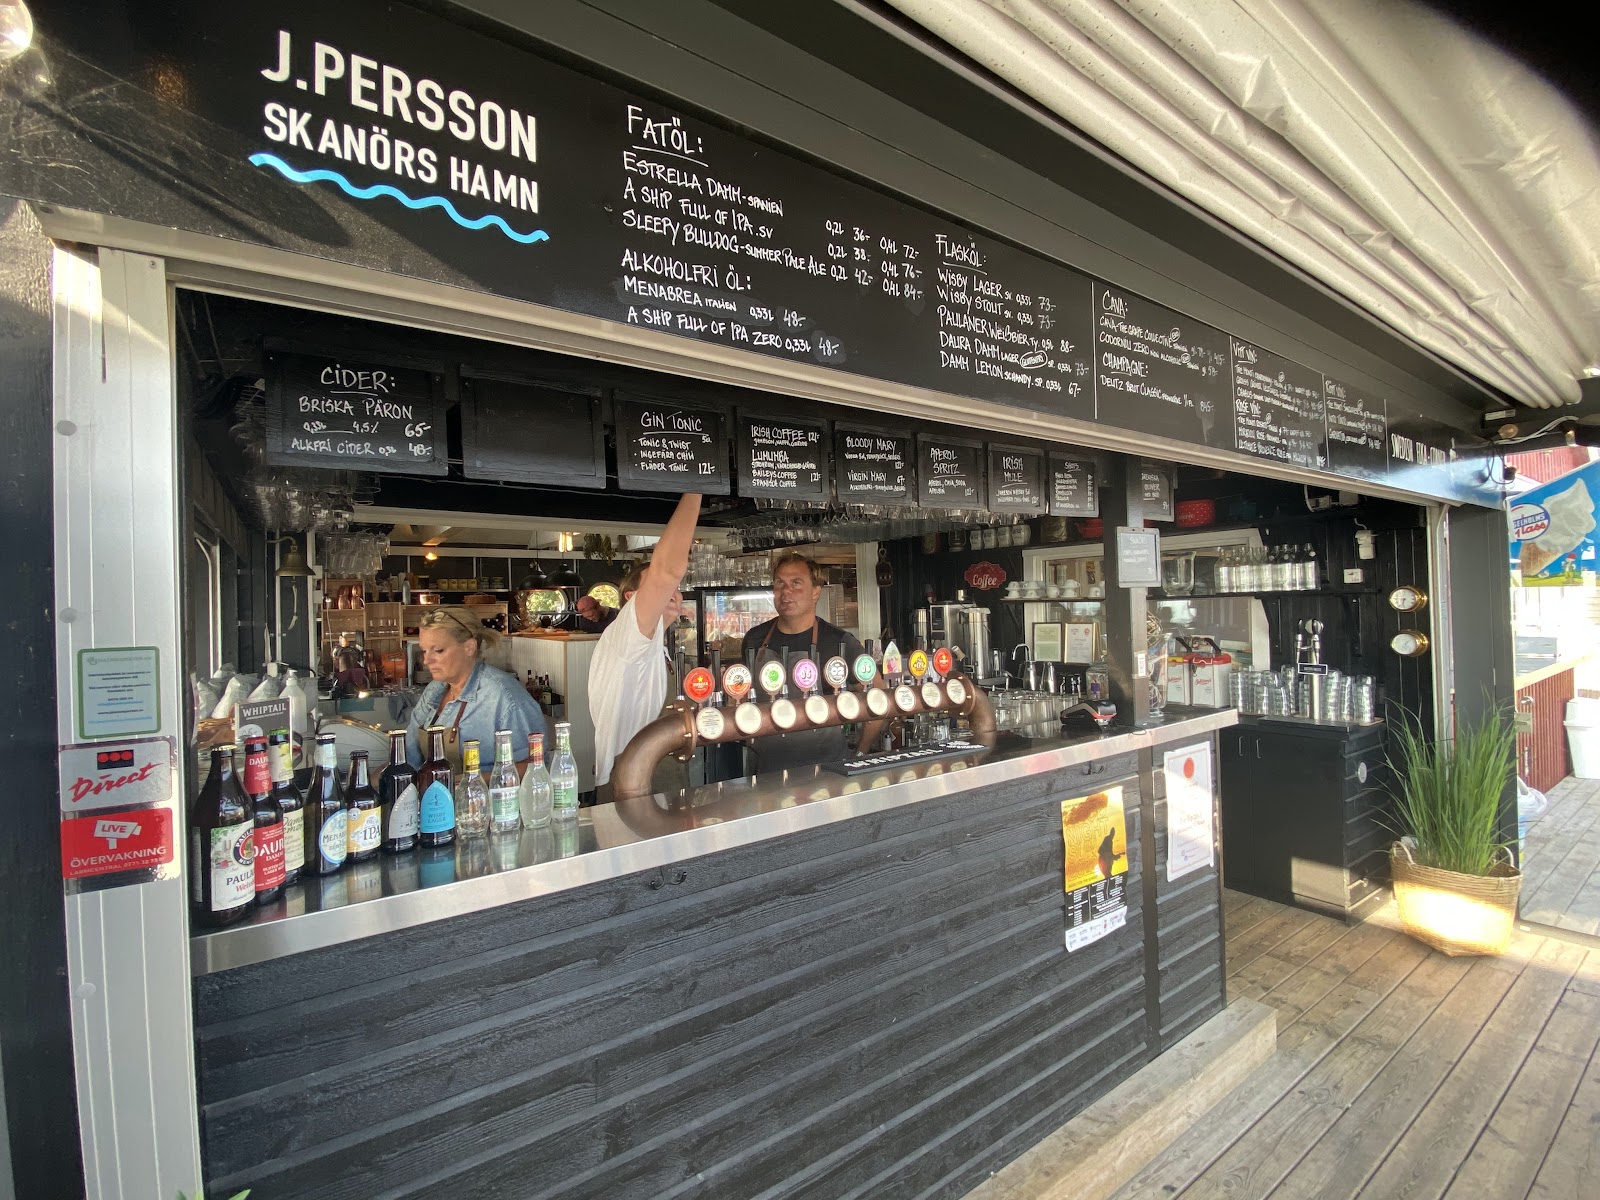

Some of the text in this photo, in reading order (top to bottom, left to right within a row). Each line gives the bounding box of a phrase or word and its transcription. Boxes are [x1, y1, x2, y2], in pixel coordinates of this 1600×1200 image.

[260, 29, 537, 163] J.PERSSON
[264, 102, 539, 214] SKANÖRS HAMN
[623, 151, 703, 195] ESTRELLA
[623, 176, 637, 202] A
[641, 185, 673, 210] SHIP
[679, 197, 711, 222] FULL
[714, 208, 729, 226] OF
[622, 209, 681, 246] SLEEPY
[782, 247, 806, 270] PALE
[808, 254, 827, 277] ALE
[622, 248, 718, 288] ALKOHOLFRI
[623, 275, 703, 307] MENABREA
[973, 276, 1003, 299] LAGER
[974, 297, 1004, 316] STOUT
[627, 306, 638, 324] A
[643, 308, 672, 331] SHIP
[676, 313, 709, 333] FULL
[711, 318, 727, 336] OF
[731, 321, 749, 343] IPA
[752, 331, 783, 349] ZERO
[937, 305, 990, 338] PAULANER
[939, 331, 973, 354] DAURA
[974, 338, 1001, 361] DAMM
[1001, 351, 1020, 365] LAGER
[1132, 342, 1150, 355] ZERO
[939, 350, 970, 371] DAMM
[975, 358, 1003, 380] LEMON
[1099, 374, 1125, 391] DEUTZ
[1125, 381, 1140, 394] BRUT
[299, 396, 413, 420] BRISKA PÄRON
[640, 410, 703, 432] GIN TONIC
[751, 424, 771, 440] IRISH
[771, 427, 806, 443] COFFEE
[291, 437, 332, 454] ALKFRI
[336, 440, 375, 456] CIDER
[638, 437, 661, 448] TONIC
[668, 440, 692, 451] TWIST
[846, 436, 897, 456] BLOODY MARY
[640, 449, 675, 460] INGEFÄRA
[751, 449, 790, 463] LUMUMBA
[930, 447, 958, 463] APEROL
[1002, 455, 1024, 471] IRISH
[640, 460, 667, 472] FLÄDER
[668, 462, 690, 472] TONIC
[777, 471, 798, 480] COFFEE
[933, 462, 960, 475] SPRITZ
[847, 469, 887, 487] VIRGIN MARY
[1003, 471, 1024, 482] MULE
[972, 573, 998, 589] Coffee
[242, 702, 287, 718] WHIPTAIL
[67, 761, 165, 803] Direct
[101, 824, 127, 834] LIVE
[70, 846, 167, 869] ÖVERVAKNING
